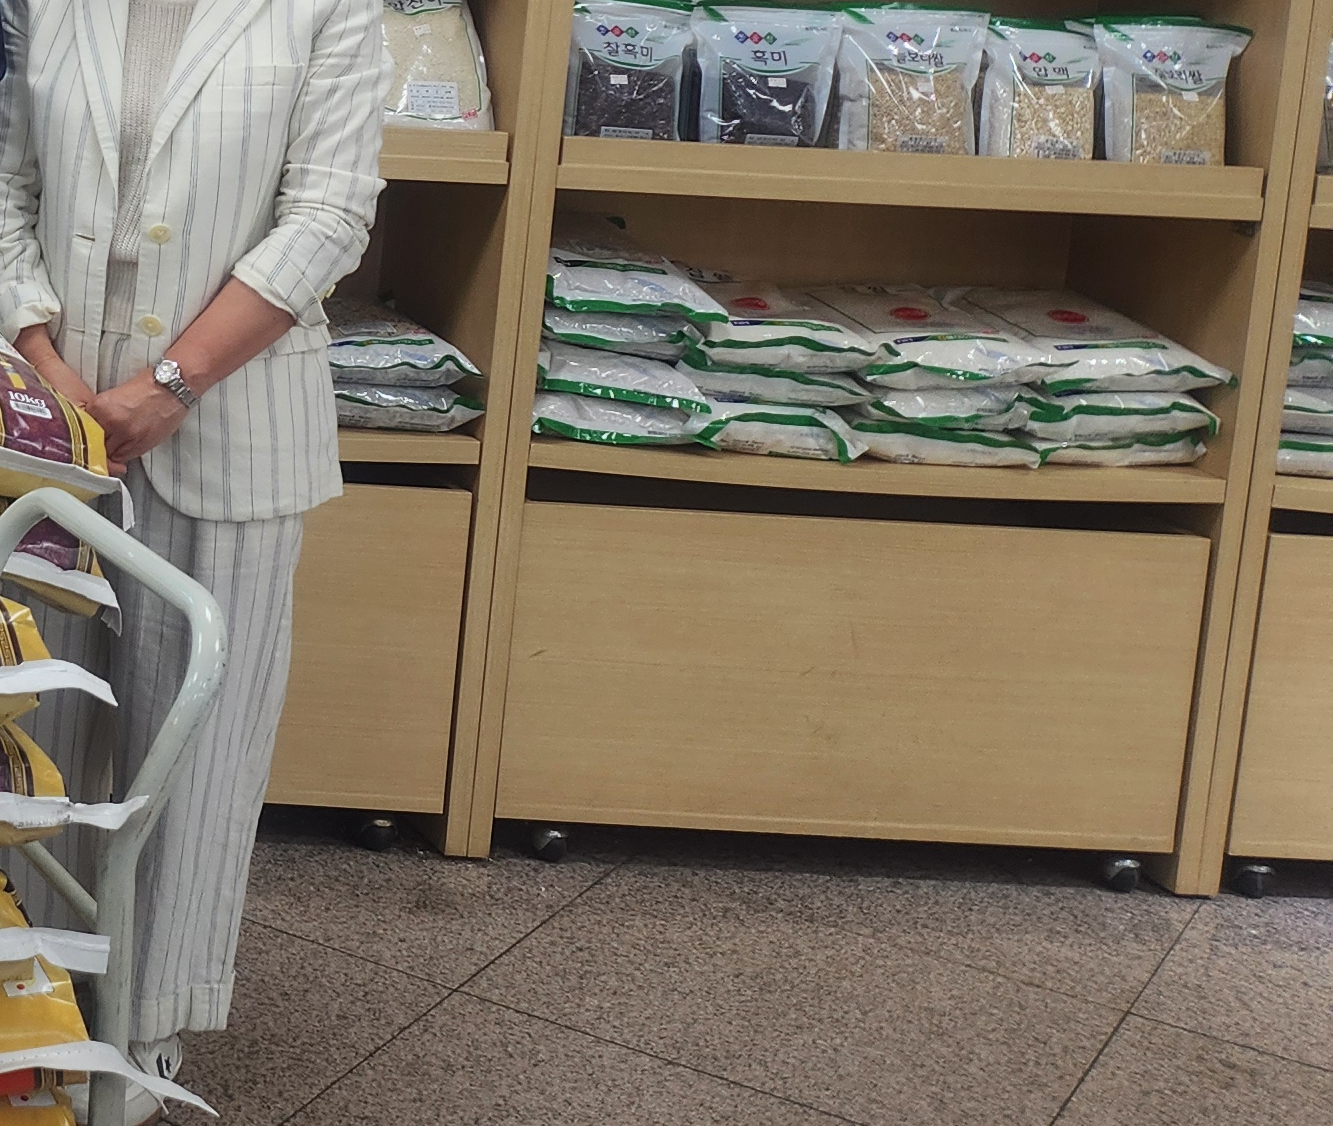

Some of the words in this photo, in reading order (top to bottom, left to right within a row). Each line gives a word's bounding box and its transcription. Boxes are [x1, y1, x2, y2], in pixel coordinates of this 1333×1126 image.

[602, 42, 654, 61] 찰흑미
[751, 50, 788, 66] 흑미
[8, 391, 46, 408] 10kg
